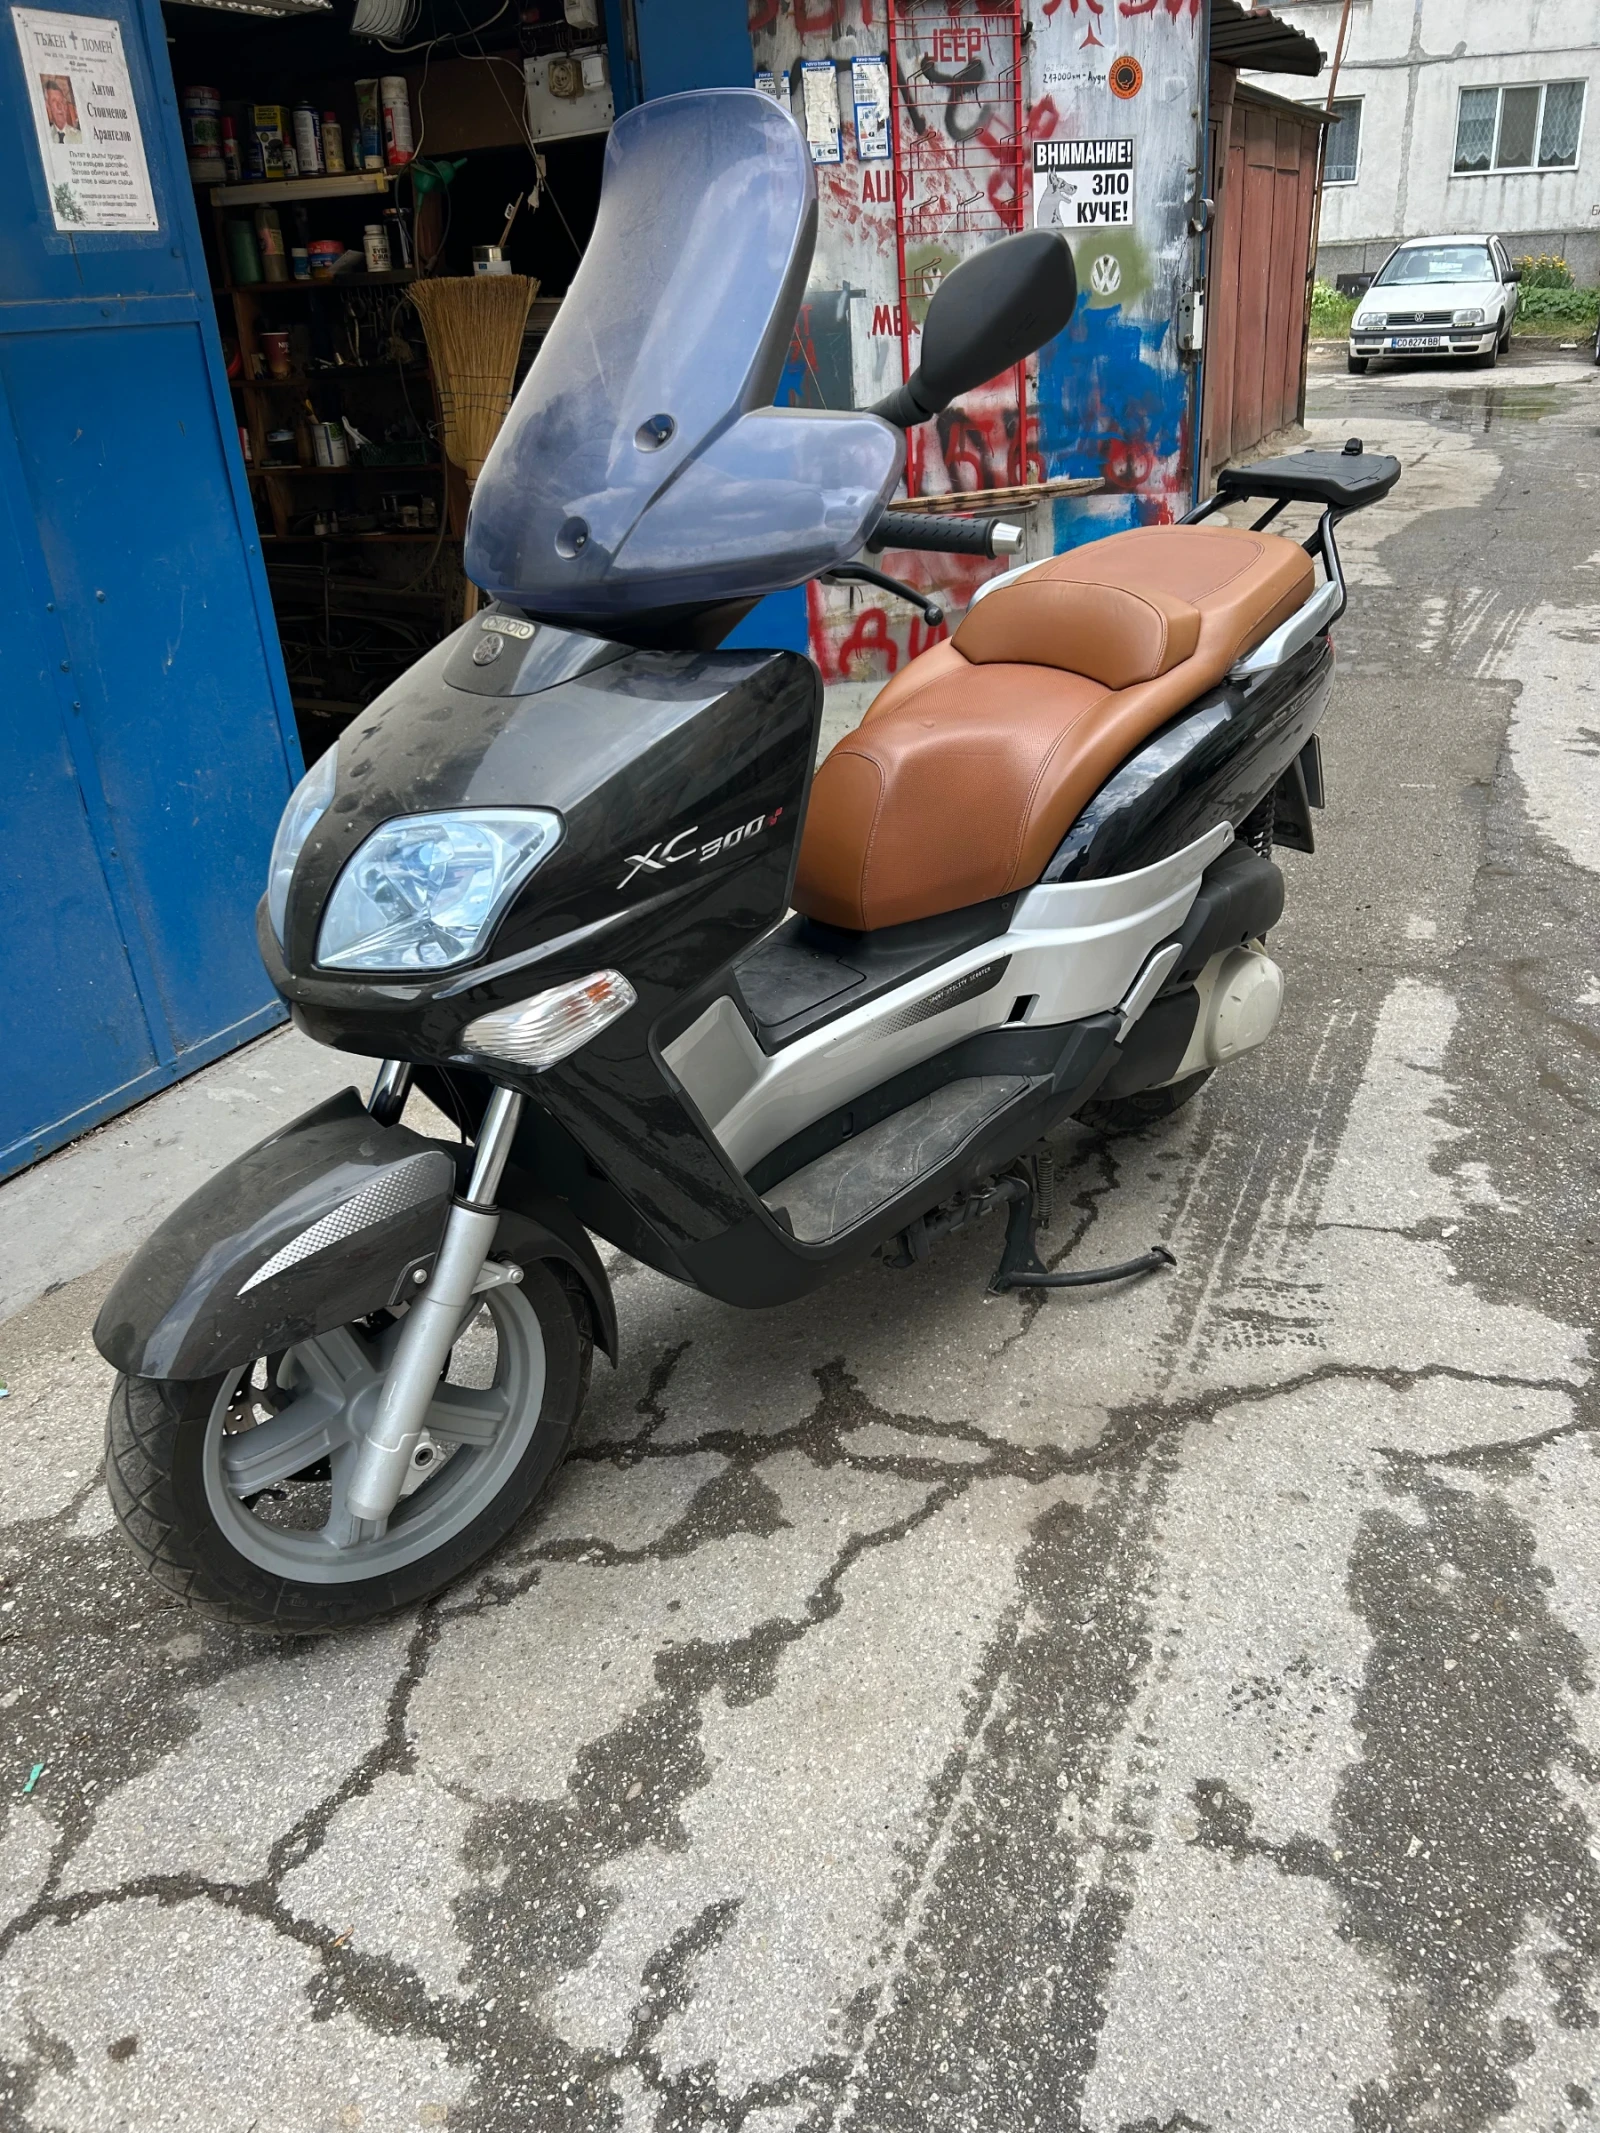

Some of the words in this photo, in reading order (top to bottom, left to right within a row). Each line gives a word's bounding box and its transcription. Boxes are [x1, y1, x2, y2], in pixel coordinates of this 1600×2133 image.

[33, 32, 67, 48] ТЪЖЕН
[81, 38, 113, 54] ПОМЕН
[924, 27, 982, 62] JEEP
[92, 81, 116, 96] Антон
[87, 102, 128, 119] Стоименов
[1036, 141, 1132, 166] ВНИМАНИЕ!
[862, 168, 915, 204] AUDI
[1092, 173, 1129, 195] ЗЛО
[1077, 201, 1128, 223] КУЧЕ!
[616, 825, 699, 890] XC
[969, 966, 992, 982] SCOOTER
